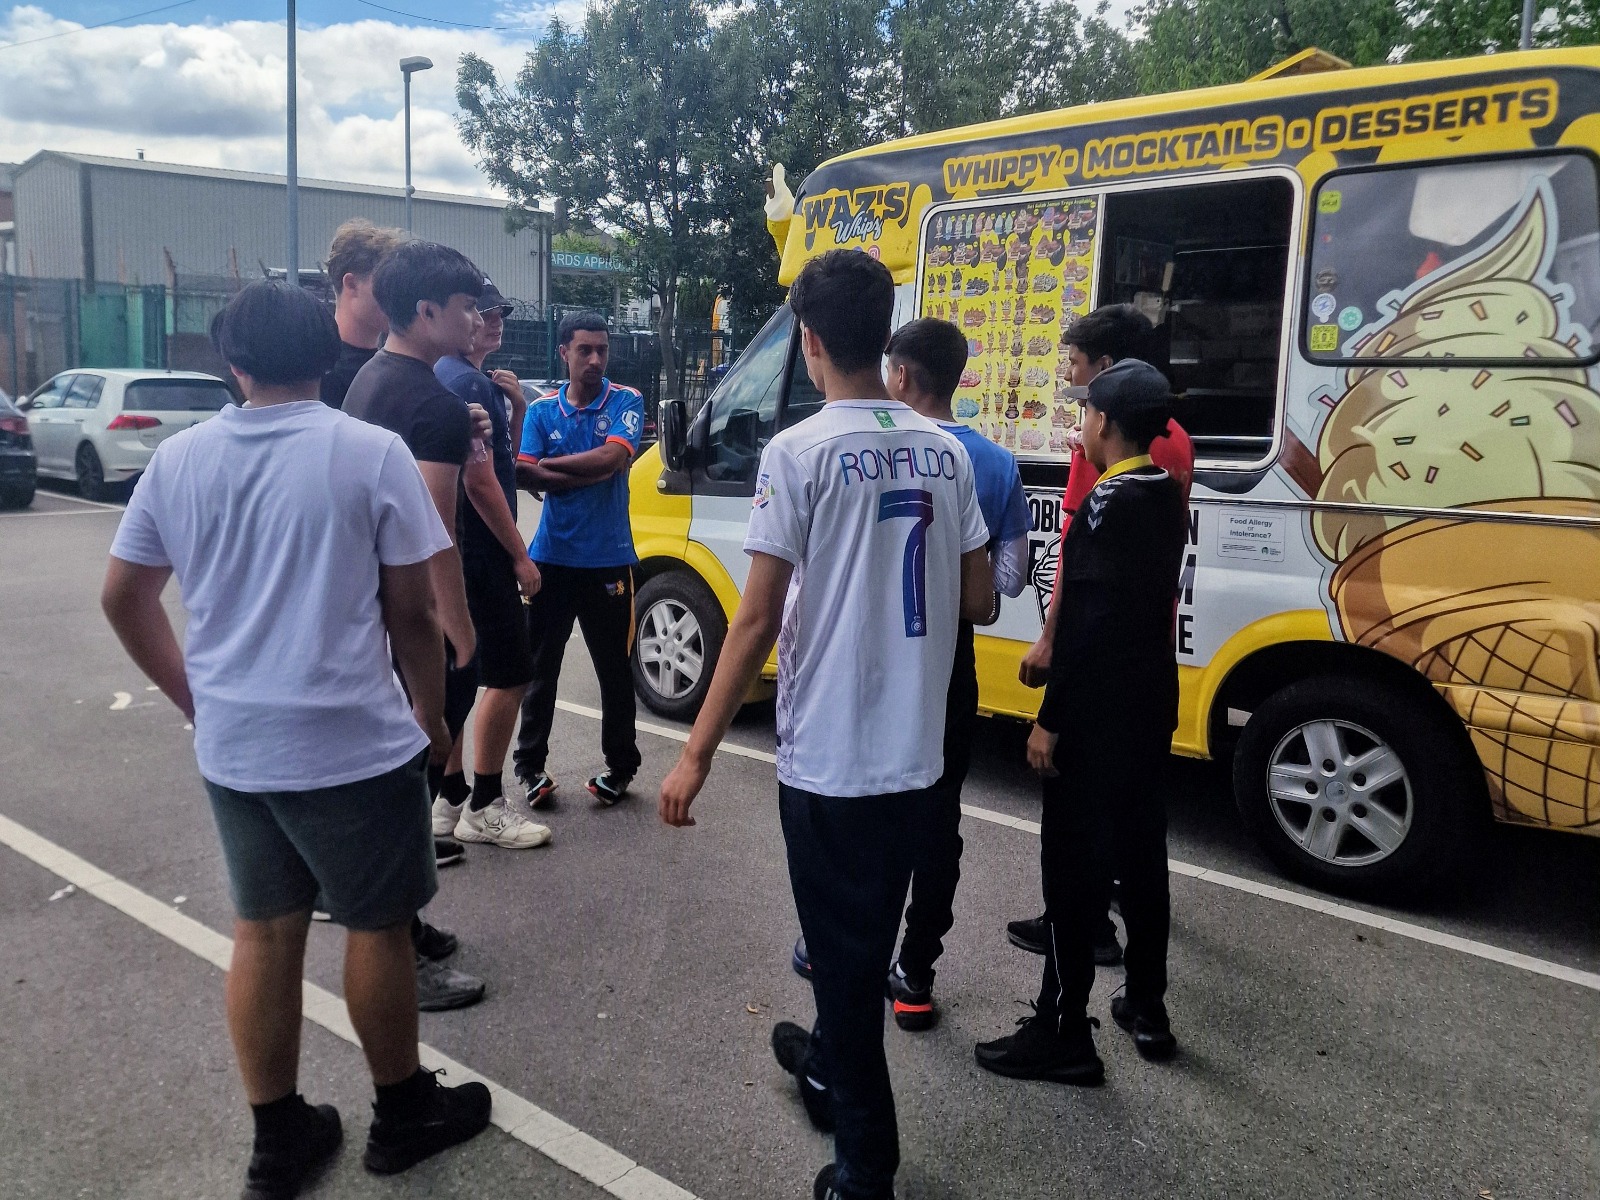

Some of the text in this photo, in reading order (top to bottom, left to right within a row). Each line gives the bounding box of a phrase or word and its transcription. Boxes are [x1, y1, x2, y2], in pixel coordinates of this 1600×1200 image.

[947, 87, 1551, 187] WHIPPY MOCKTAILS DESSERTS
[804, 186, 907, 230] WAZ'S
[551, 253, 580, 266] ARDS
[839, 447, 956, 486] RONALDO
[1229, 530, 1272, 539] Intolerance?
[1248, 519, 1273, 528] Allergy
[877, 489, 935, 638] 7
